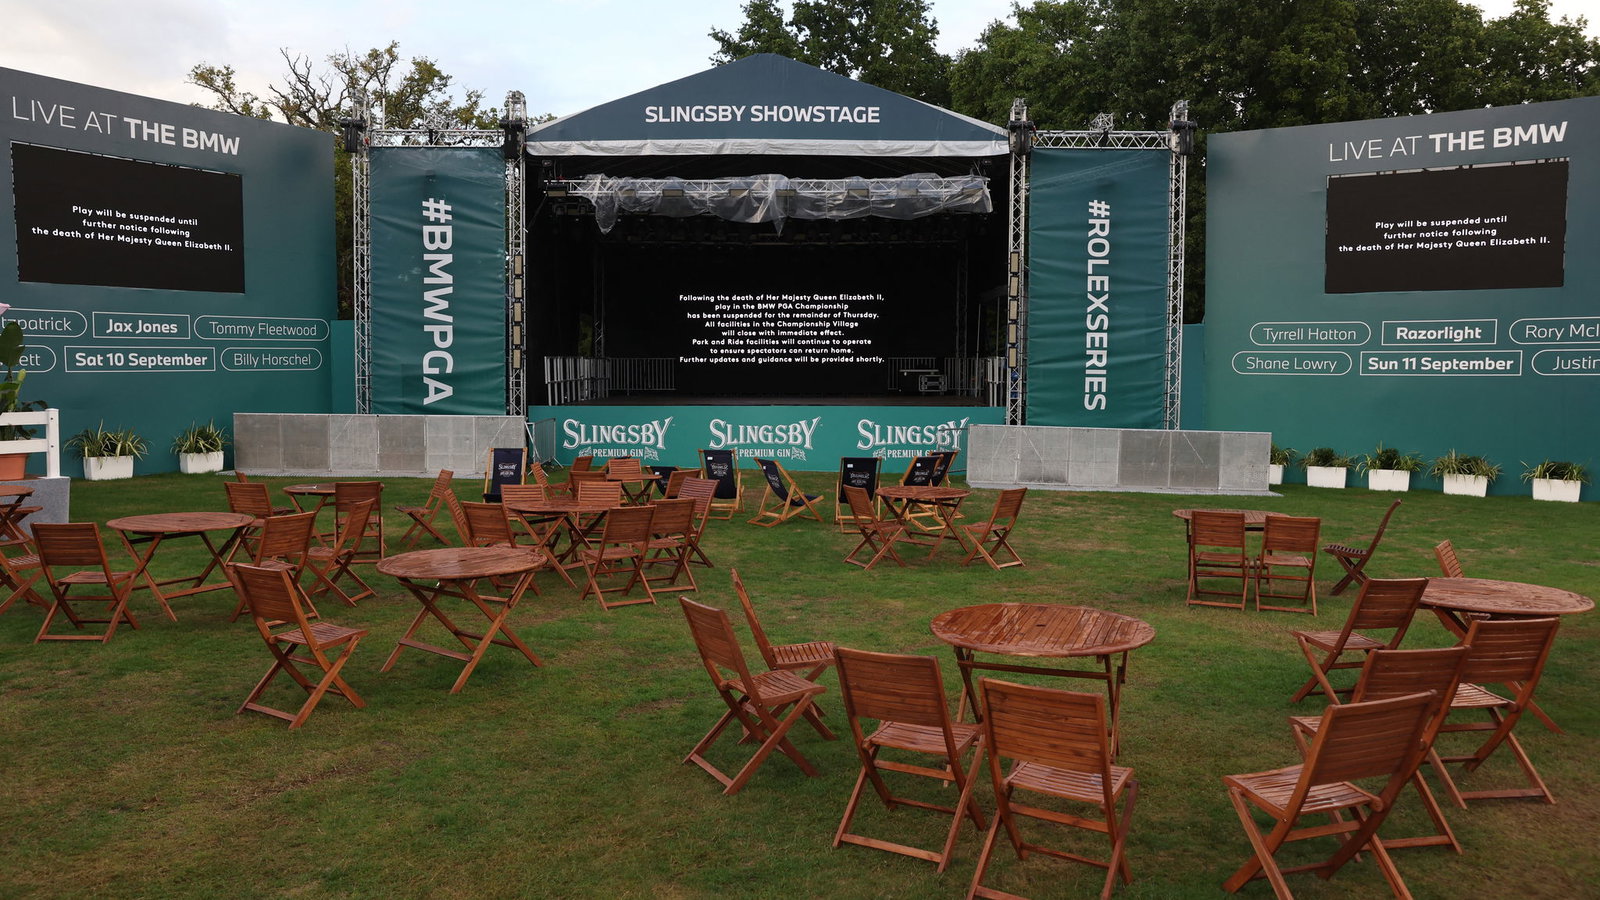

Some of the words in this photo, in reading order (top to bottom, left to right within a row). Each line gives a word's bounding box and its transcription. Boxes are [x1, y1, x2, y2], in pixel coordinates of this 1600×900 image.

[645, 105, 746, 123] SLINGSBY
[751, 105, 880, 123] SHOWSTAGE
[12, 96, 76, 129] LIVE
[84, 111, 117, 134] AT
[123, 117, 176, 145] THE
[183, 128, 240, 155] BMW
[1330, 139, 1382, 162] LIVE
[1390, 135, 1422, 157] AT
[1429, 130, 1485, 153] THE
[1493, 121, 1568, 148] BMW
[72, 205, 93, 216] Play
[96, 209, 112, 217] will
[116, 210, 126, 218] be
[130, 214, 175, 223] suspended
[82, 219, 116, 229] further
[120, 224, 147, 232] notice
[150, 226, 190, 238] following
[1375, 222, 1394, 230] Play
[1397, 220, 1413, 228] will
[1430, 217, 1480, 227] suspended
[1484, 215, 1507, 223] until
[32, 227, 49, 235] the
[52, 229, 81, 238] death
[117, 234, 152, 246] Majesty
[155, 238, 182, 247] Queen
[185, 240, 222, 250] Elizabeth
[1419, 230, 1449, 238] notice
[1452, 228, 1497, 236] following
[1416, 242, 1453, 250] Majesty
[1490, 237, 1536, 246] Elizabeth
[421, 197, 455, 406] #BMWPGA
[782, 294, 811, 302] Majesty
[1083, 199, 1111, 411] #ROLEXSERIES
[715, 303, 731, 311] play
[2, 316, 72, 331] tpatrick
[106, 319, 133, 333] Jax
[136, 320, 178, 334] Jones
[209, 321, 255, 337] Tommy
[258, 322, 316, 336] Fleetwood
[1263, 328, 1303, 343] Tyrrell
[1308, 328, 1356, 340] Hatton
[1396, 326, 1482, 342] Razorlight
[1526, 325, 1564, 341] Rory
[75, 352, 103, 366] Sat
[106, 353, 124, 366] 10
[128, 353, 208, 368] September
[234, 353, 259, 368] Billy
[262, 353, 311, 365] Horschel
[758, 356, 792, 364] guidance
[822, 356, 854, 364] provided
[856, 356, 884, 364] shortly.
[1246, 356, 1290, 370] Shane
[1294, 357, 1337, 372] Lowry
[1368, 357, 1398, 370] Sun
[1402, 357, 1416, 370] 11
[1421, 357, 1514, 373] September
[562, 416, 673, 450] SLINGSBY
[708, 416, 821, 450] SLINGSBY
[856, 416, 970, 450] SLINGSBY
[592, 448, 628, 458] PREMIUM
[629, 448, 644, 458] GIN
[739, 448, 775, 458] PREMIUM
[776, 448, 791, 458] GIN
[886, 449, 923, 459] PREMIUM
